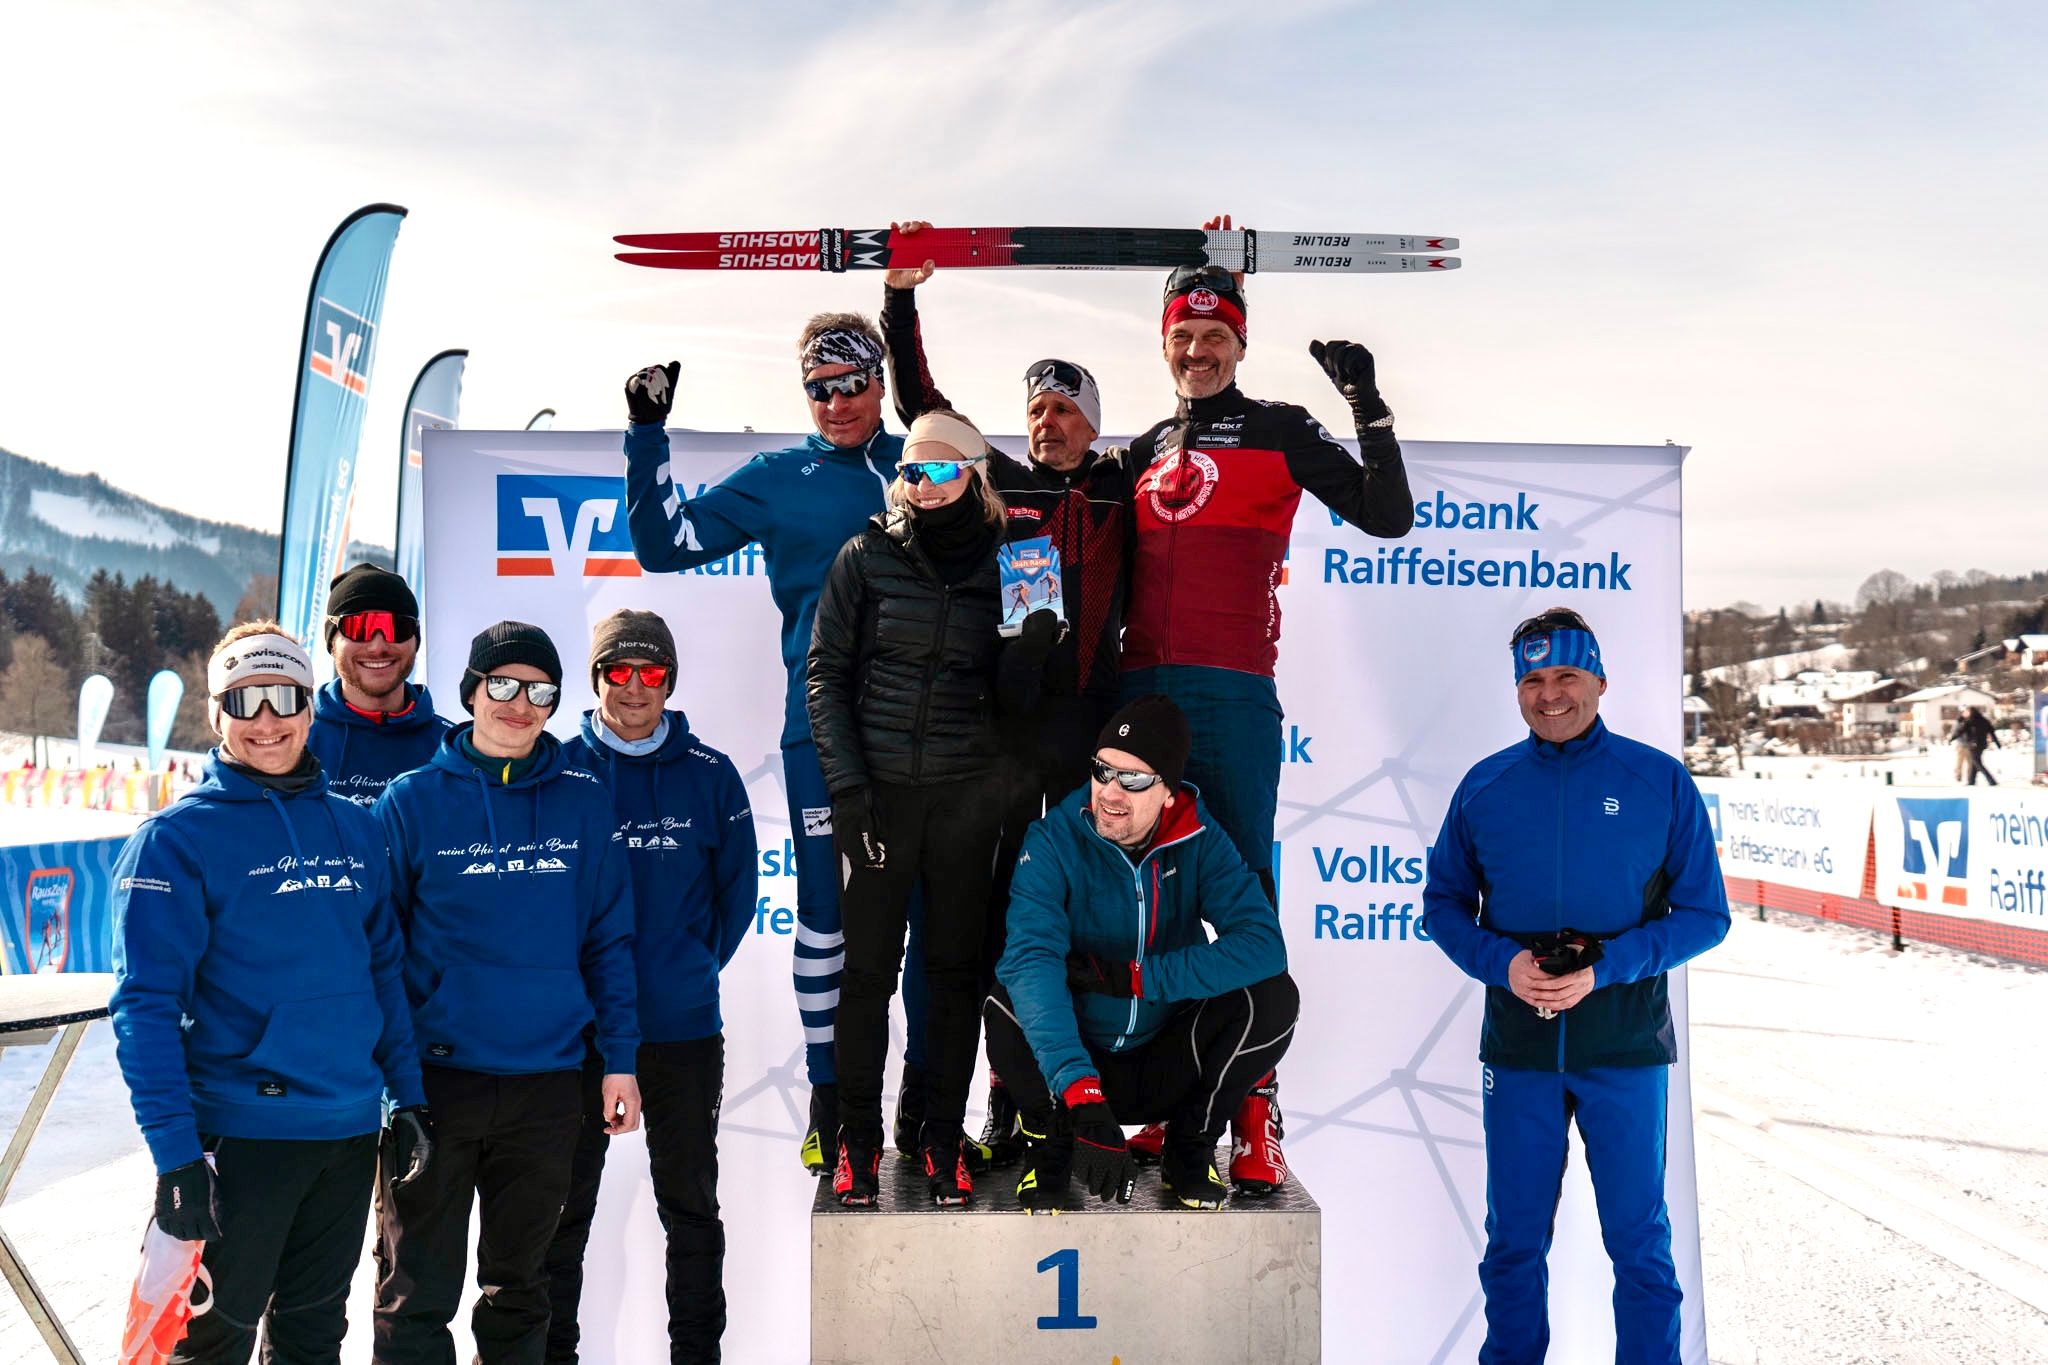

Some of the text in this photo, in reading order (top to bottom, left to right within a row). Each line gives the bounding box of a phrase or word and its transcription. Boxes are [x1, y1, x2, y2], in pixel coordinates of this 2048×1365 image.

[718, 233, 820, 248] MADSHUS
[1292, 235, 1350, 247] REDLINE
[719, 253, 820, 268] MADSHUS
[1294, 255, 1352, 267] REDLINE
[1193, 454, 1215, 479] HELFEN
[1324, 547, 1632, 590] Raiffeisenbank
[618, 641, 660, 652] Norway
[243, 648, 306, 671] swisscom
[661, 816, 692, 831] Bank
[545, 837, 579, 852] Bank
[1124, 1180, 1133, 1200] LEKI
[1036, 1249, 1097, 1329] 1
